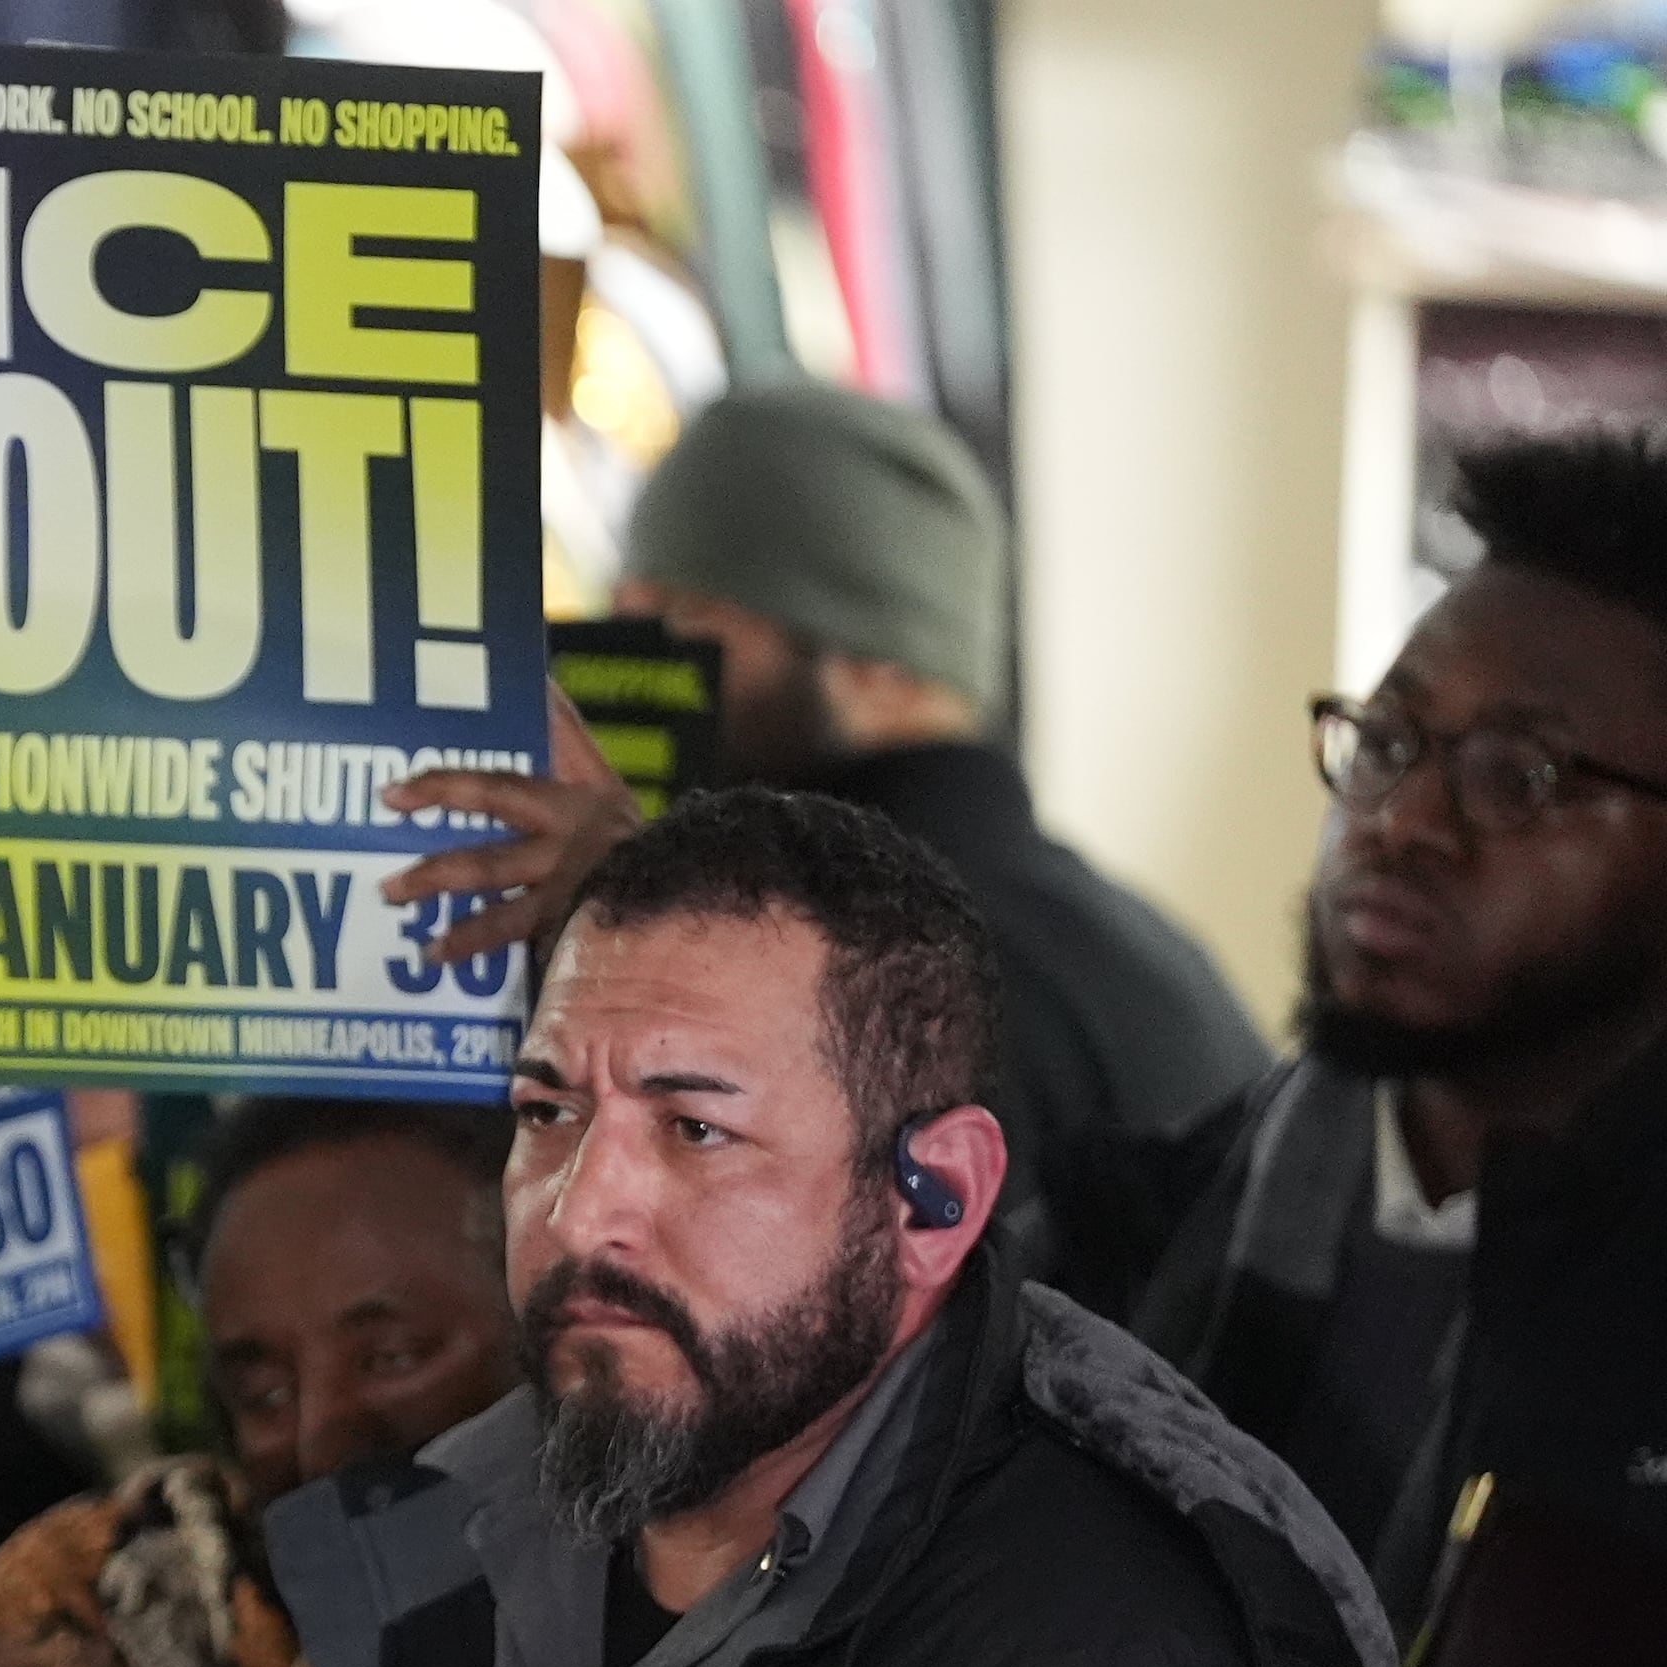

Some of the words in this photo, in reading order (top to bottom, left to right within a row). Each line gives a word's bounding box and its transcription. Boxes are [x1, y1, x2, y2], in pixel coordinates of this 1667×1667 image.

[72, 87, 123, 136] NO
[126, 90, 274, 144] SCHOOL.
[280, 97, 328, 146] NO
[335, 99, 520, 156] SHOPPING.
[385, 884, 510, 997] 30
[23, 1010, 57, 1050] IN
[62, 1011, 231, 1056] DOWNTOWN
[237, 1017, 445, 1069] MINNEAPOLIS,
